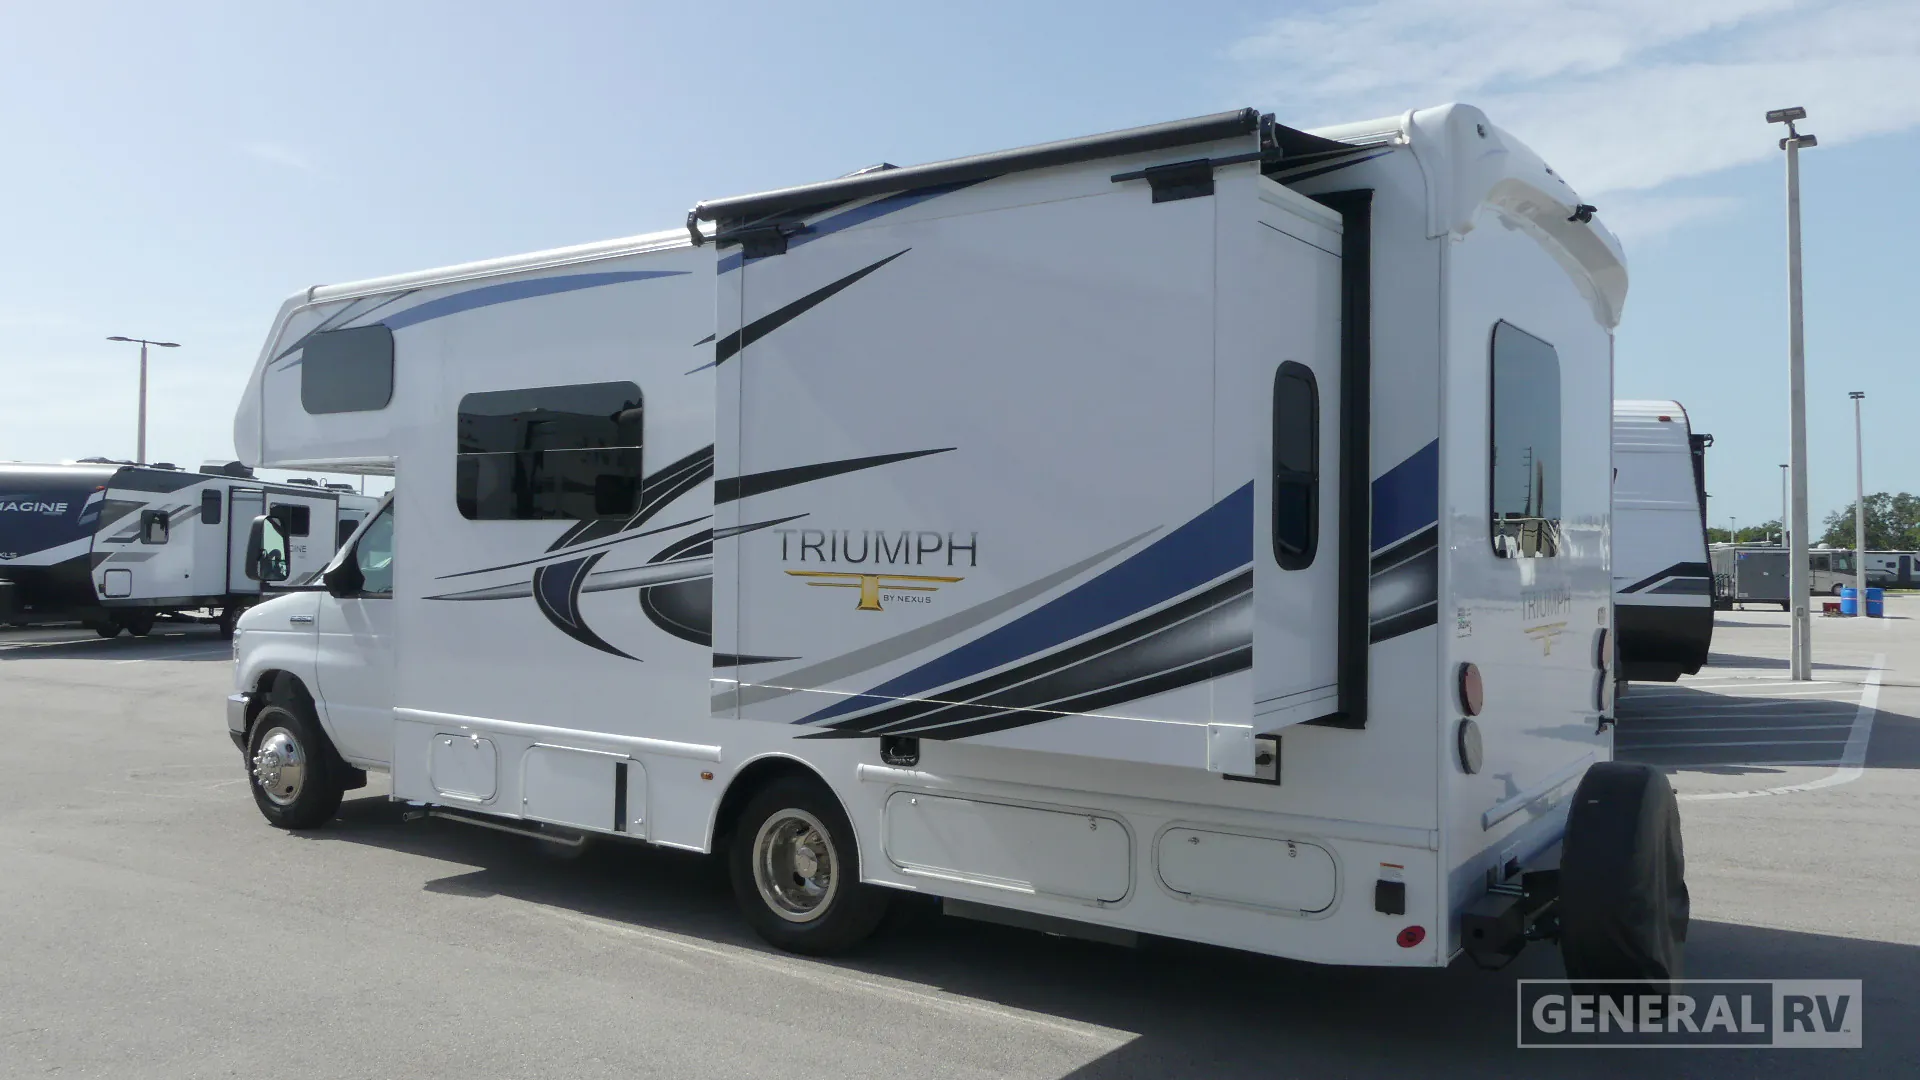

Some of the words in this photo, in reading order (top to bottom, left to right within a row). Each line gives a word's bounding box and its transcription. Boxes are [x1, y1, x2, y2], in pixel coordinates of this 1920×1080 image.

[773, 529, 978, 567] TRIUMPH
[883, 594, 895, 602] BY
[897, 595, 932, 604] NEXUS
[1520, 586, 1572, 621] TRIUMPH
